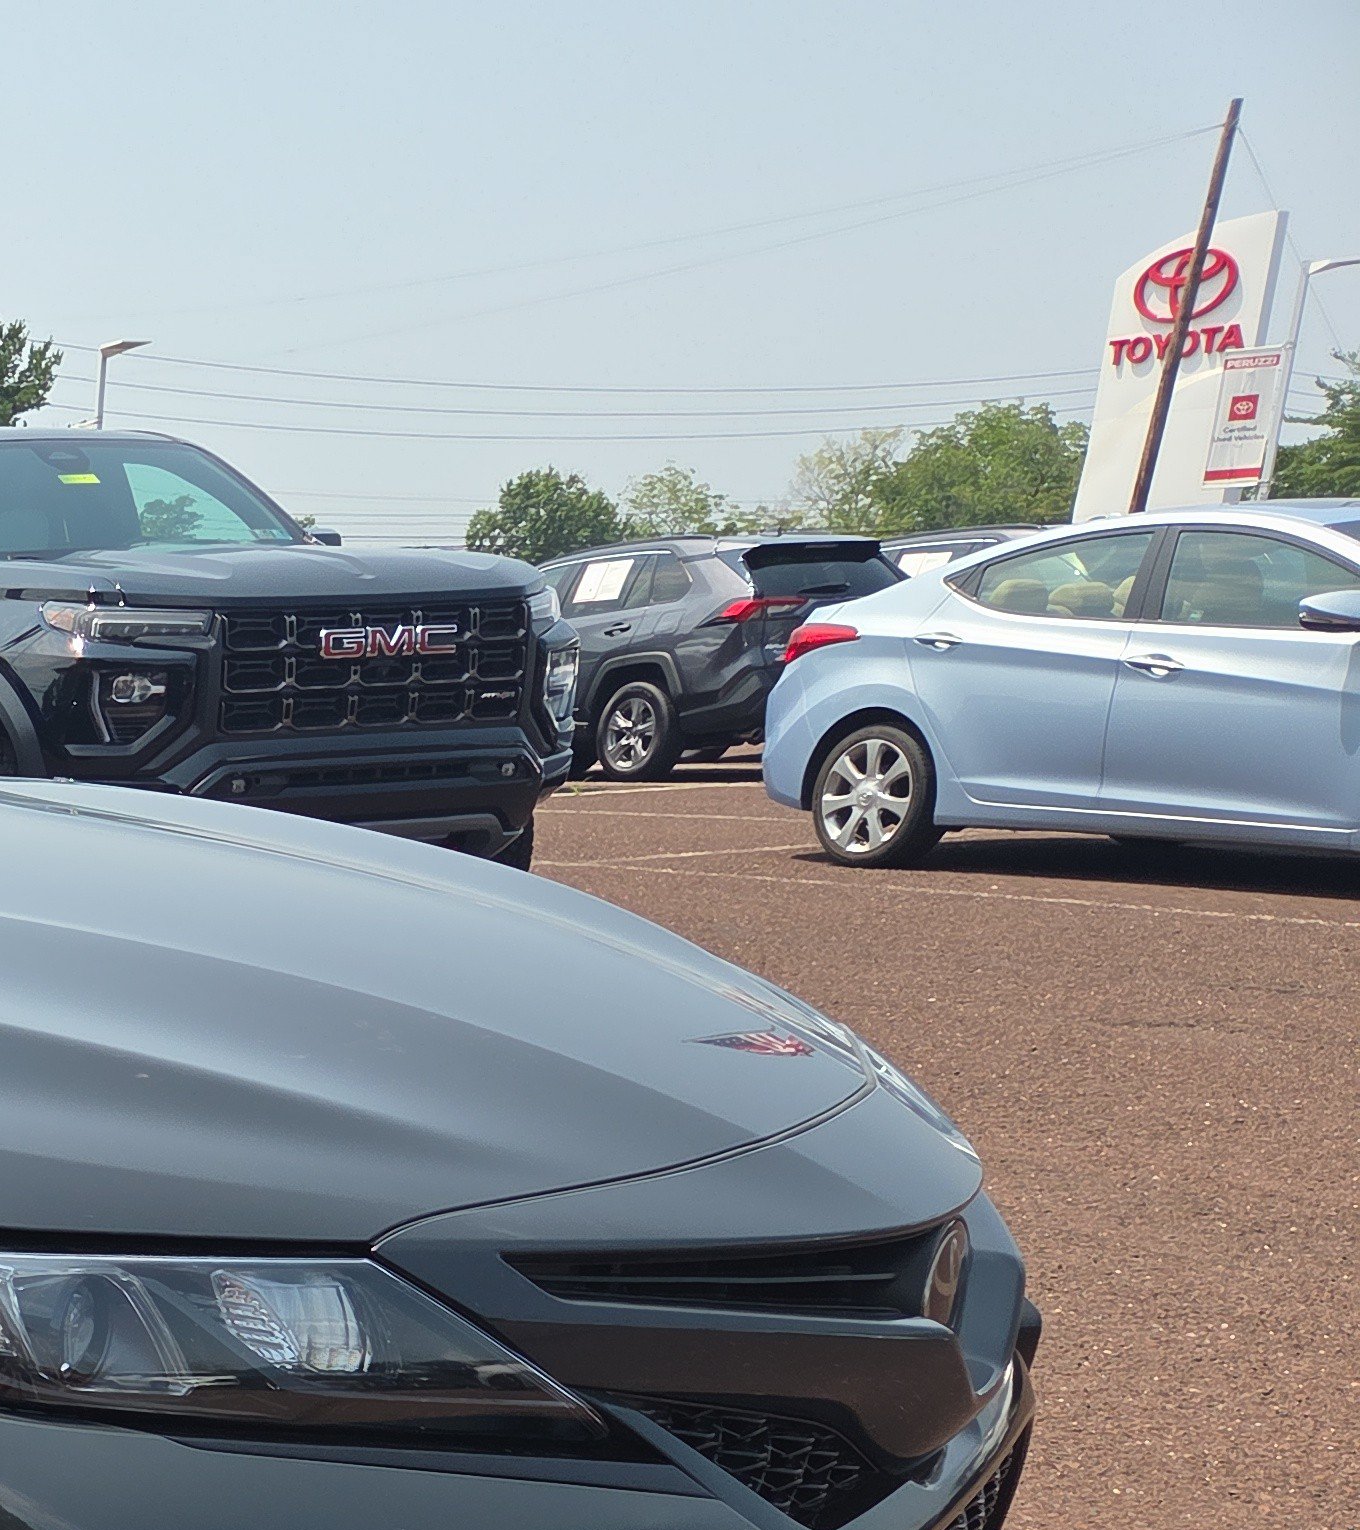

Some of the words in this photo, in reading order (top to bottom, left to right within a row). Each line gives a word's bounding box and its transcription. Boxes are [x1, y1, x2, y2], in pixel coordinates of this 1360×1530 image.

[1109, 324, 1245, 366] TOYOTA
[1226, 356, 1278, 368] PERUZZI
[320, 624, 458, 658] GMC
